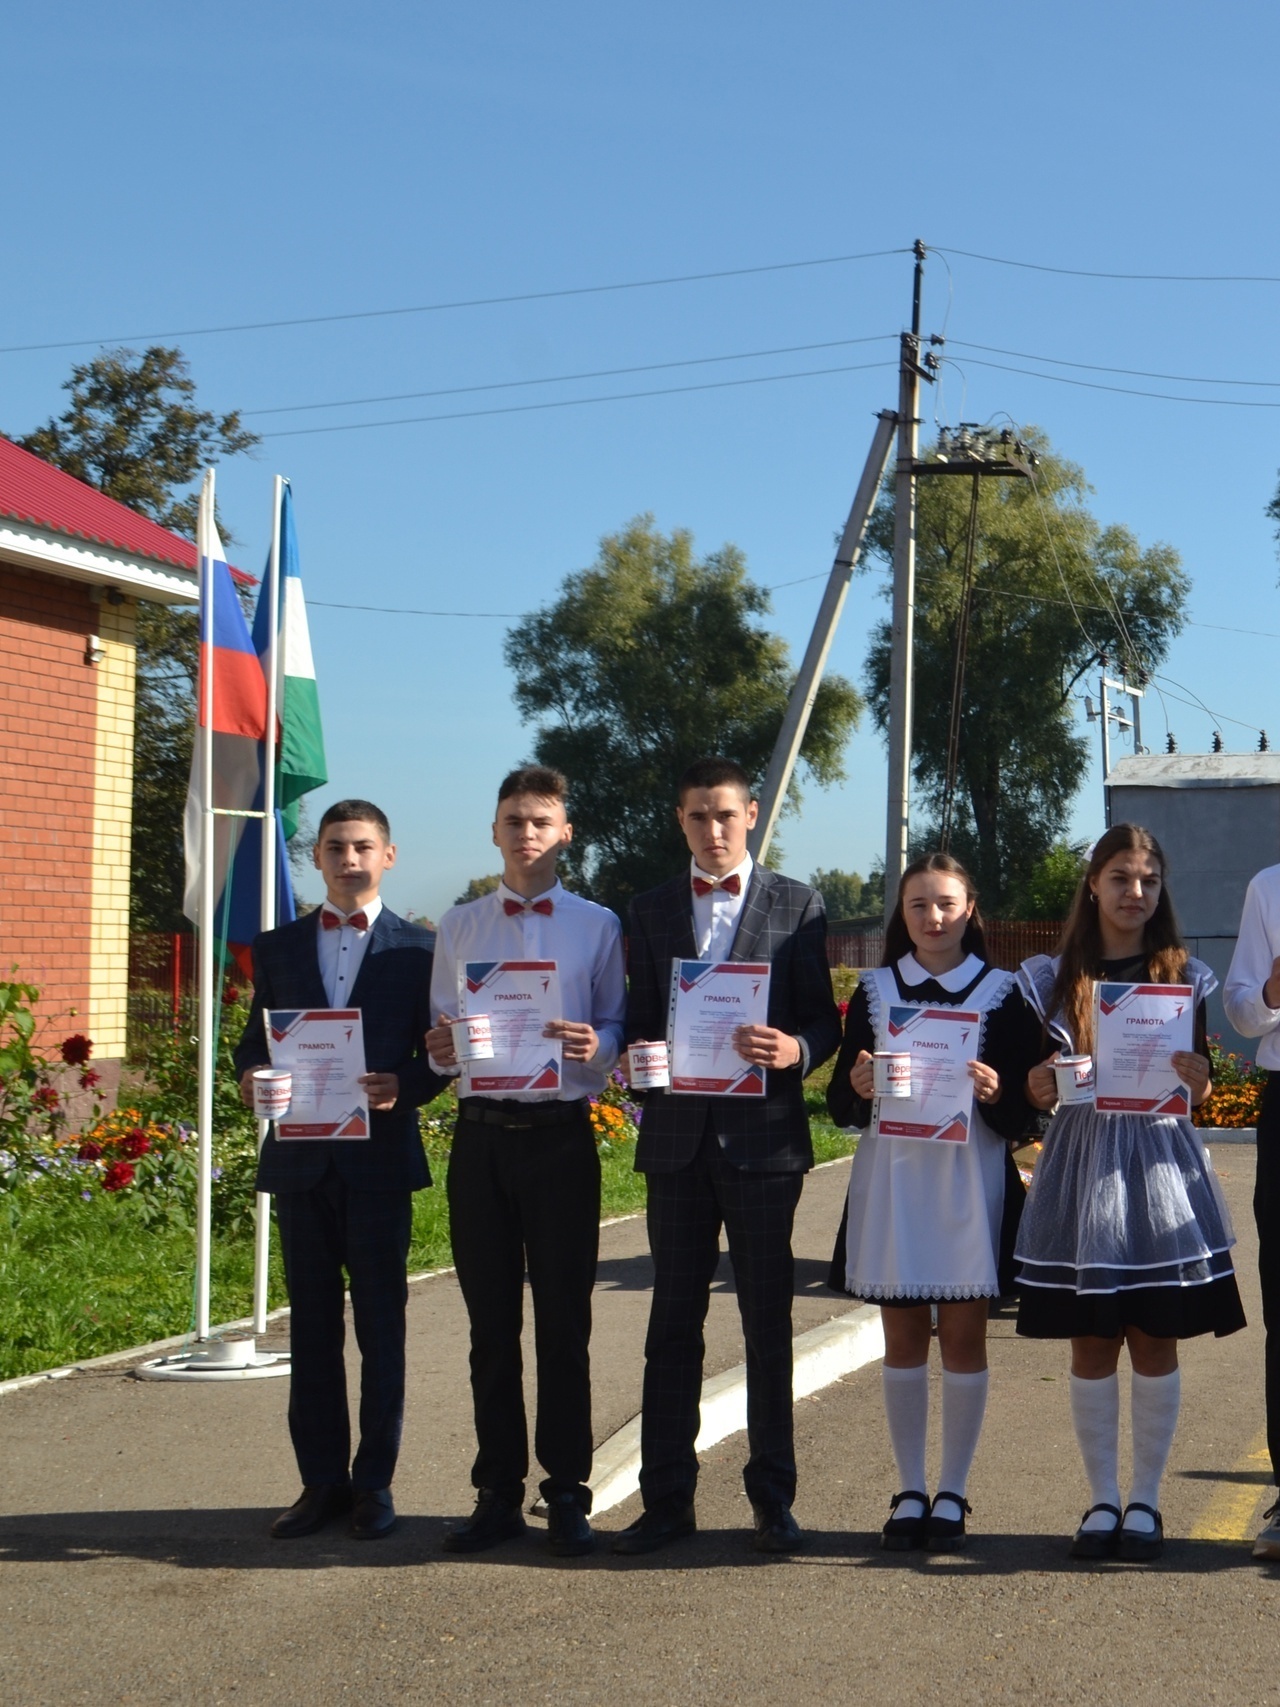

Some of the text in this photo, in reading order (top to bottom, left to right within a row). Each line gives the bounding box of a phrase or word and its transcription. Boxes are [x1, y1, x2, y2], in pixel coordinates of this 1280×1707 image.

[494, 993, 533, 1001] ГРАМОТА
[703, 995, 741, 1004] ГРАМОТА
[1126, 1018, 1165, 1026] ГРАМОТА
[467, 1025, 491, 1036] Перв
[912, 1041, 949, 1050] ГРАМОТА
[887, 1063, 912, 1075] Перв
[1074, 1070, 1093, 1081] Пер
